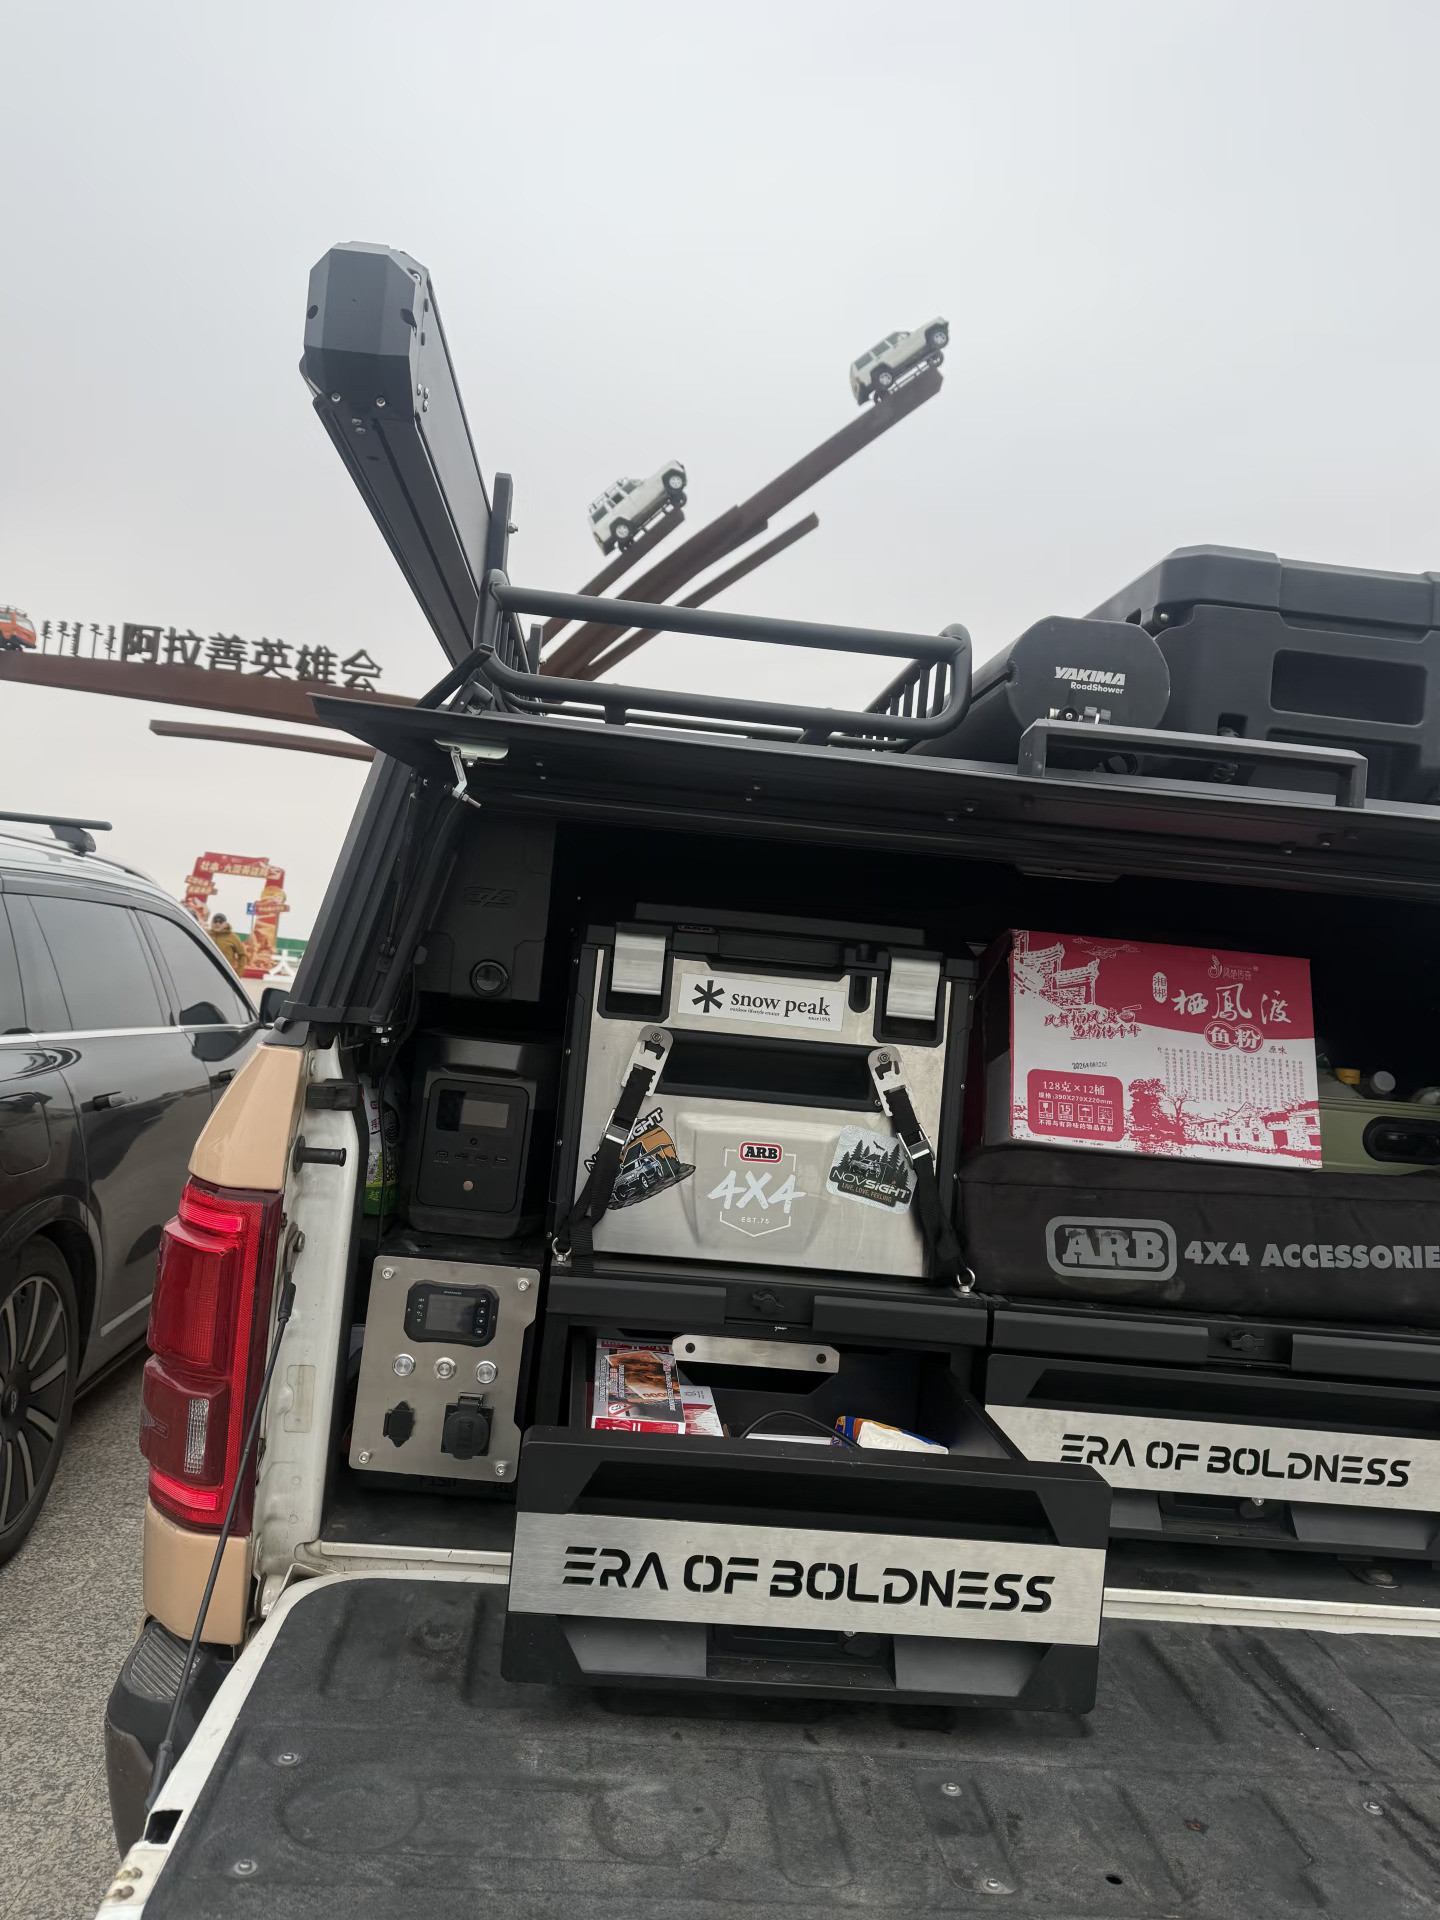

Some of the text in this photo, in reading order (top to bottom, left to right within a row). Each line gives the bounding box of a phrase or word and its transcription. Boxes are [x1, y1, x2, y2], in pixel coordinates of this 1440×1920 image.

[122, 622, 384, 694] 阿拉善英雄会
[1054, 666, 1126, 686] YAKIMA
[1070, 681, 1124, 694] RoadShower
[731, 992, 831, 1018] snow peak
[1208, 1026, 1261, 1049] 鱼粉
[1268, 1045, 1287, 1055] 原味
[744, 1146, 778, 1160] ARB
[707, 1170, 807, 1213] 4X4
[741, 1216, 770, 1225] EST.75
[1063, 1227, 1166, 1268] ARB
[1184, 1240, 1250, 1266] 4X4
[1060, 1433, 1412, 1488] ERA OF BOLDNESS
[562, 1545, 1056, 1613] ERA OF BOLDNESS
